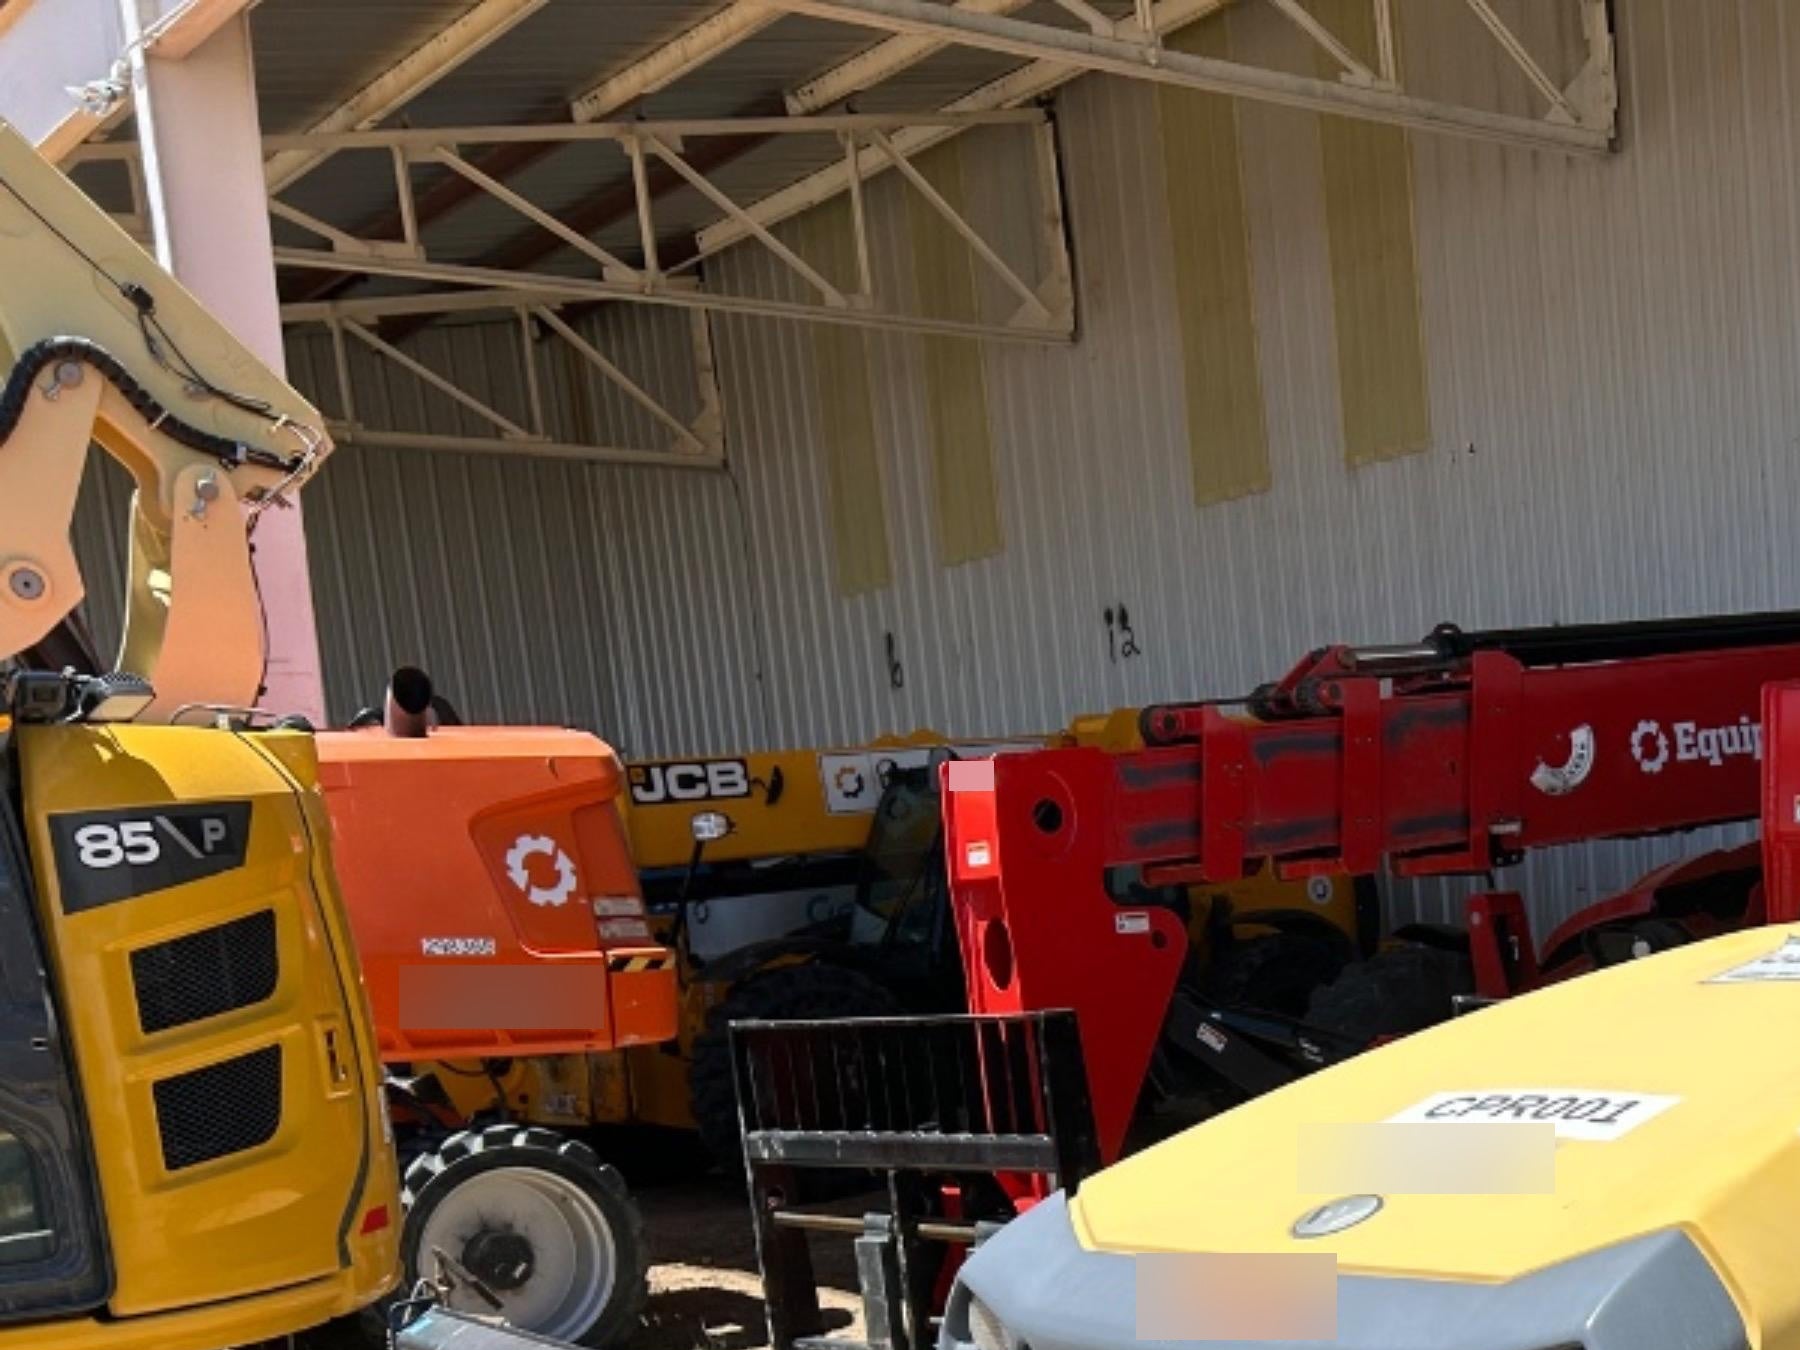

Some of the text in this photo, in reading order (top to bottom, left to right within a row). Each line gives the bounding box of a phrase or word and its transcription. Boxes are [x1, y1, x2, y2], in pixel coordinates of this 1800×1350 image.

[631, 761, 748, 802] JCB
[74, 820, 161, 868] 85
[1424, 1093, 1641, 1124] CPR001
